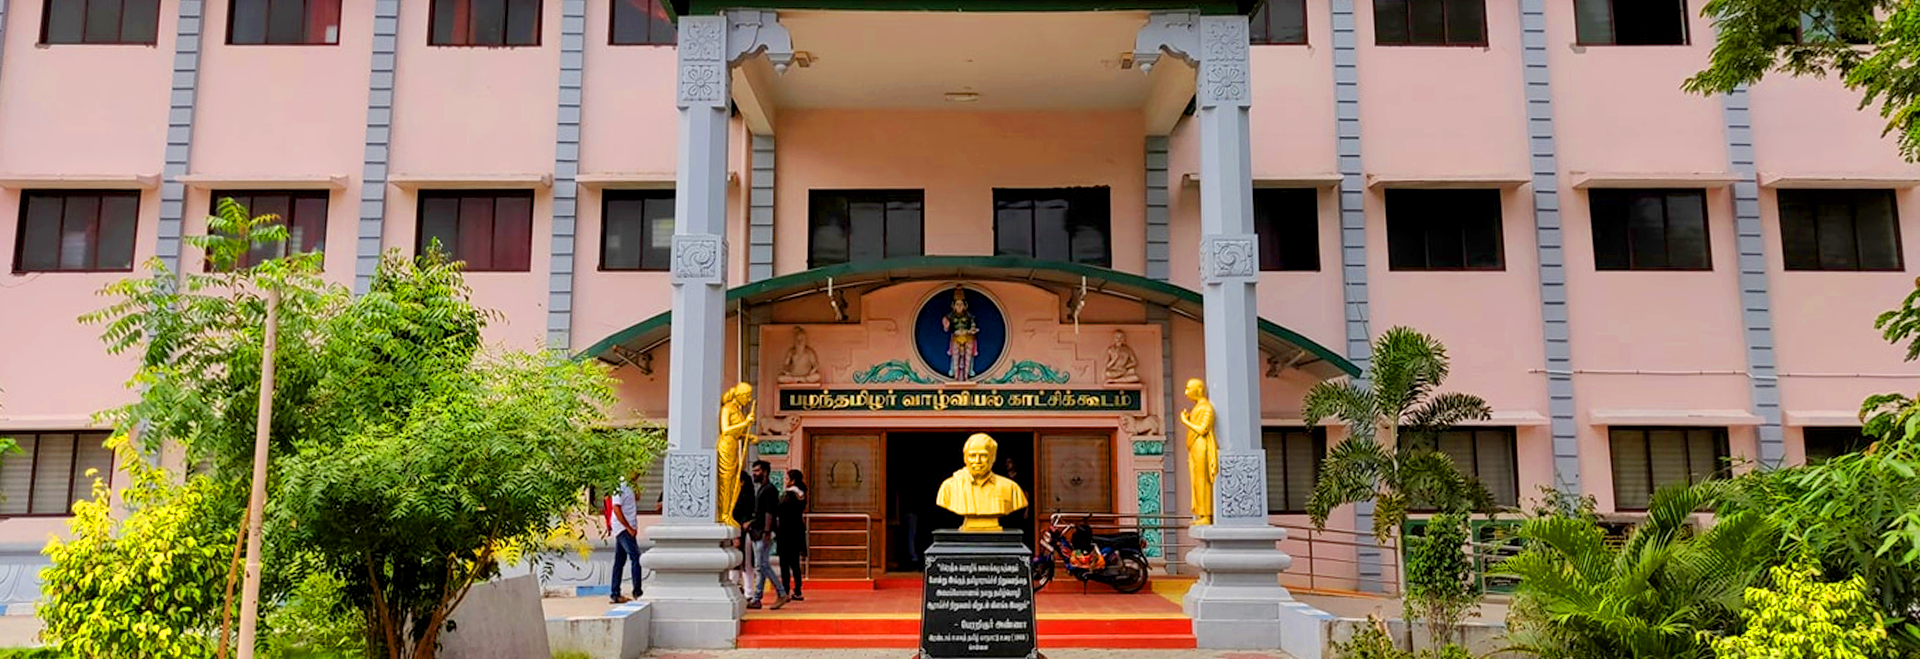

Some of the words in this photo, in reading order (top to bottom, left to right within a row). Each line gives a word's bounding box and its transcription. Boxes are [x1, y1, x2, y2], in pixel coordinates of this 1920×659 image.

[790, 389, 897, 410] பழந்தமிழர்
[902, 389, 1004, 410] வாழ்வியல்
[1008, 389, 1132, 407] காட்சிக்கூடம்
